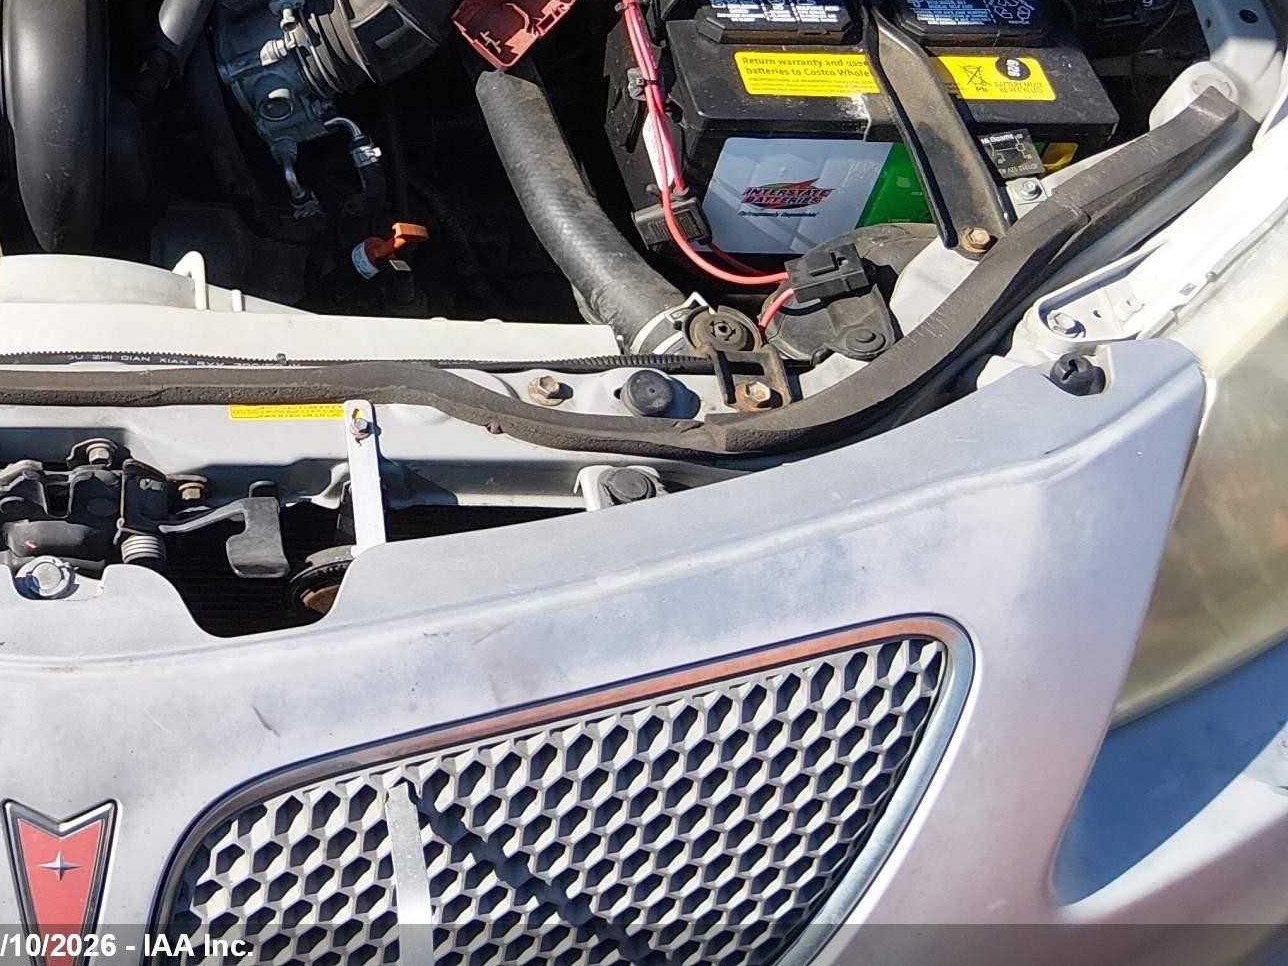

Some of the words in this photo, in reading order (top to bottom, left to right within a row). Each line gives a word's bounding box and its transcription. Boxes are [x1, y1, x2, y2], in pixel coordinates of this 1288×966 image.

[742, 57, 776, 65] Return
[777, 59, 822, 67] warranty
[746, 67, 789, 76] batteries
[792, 68, 801, 76] to
[804, 68, 836, 76] Costco
[839, 69, 871, 77] Whole
[743, 187, 833, 196] INTERSTATE
[741, 196, 823, 204] BATTERIES
[159, 357, 189, 365] XIAN
